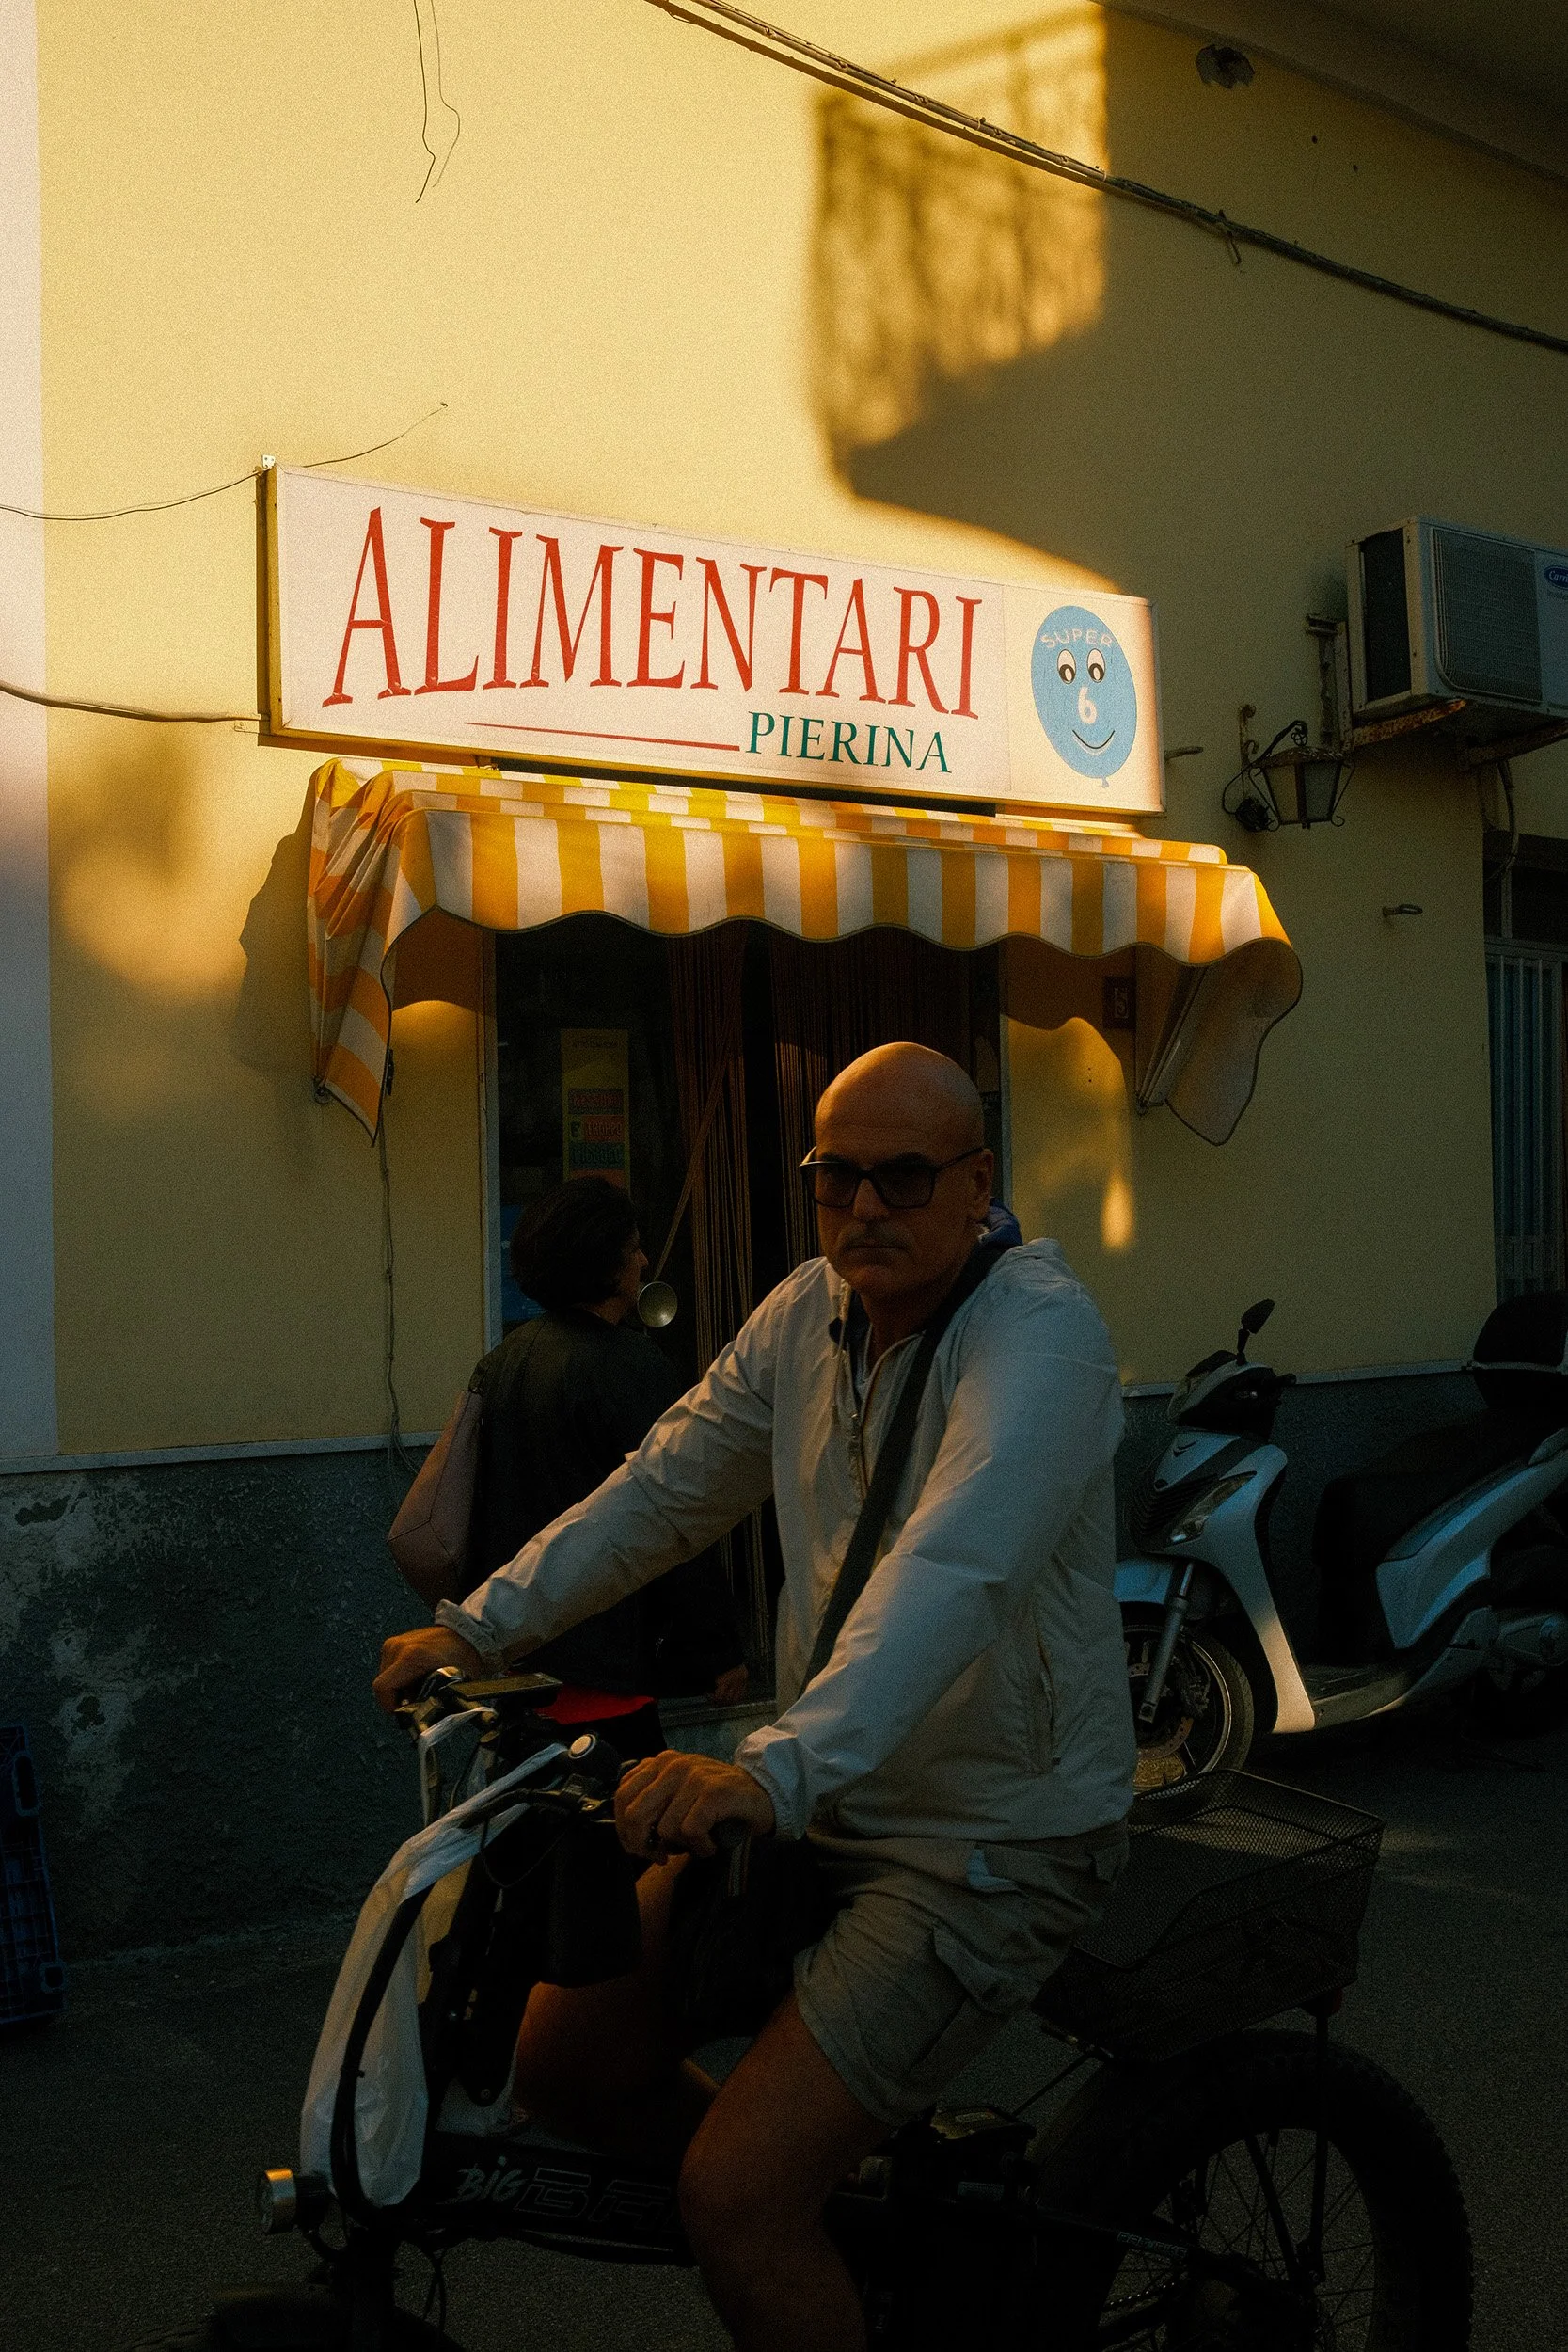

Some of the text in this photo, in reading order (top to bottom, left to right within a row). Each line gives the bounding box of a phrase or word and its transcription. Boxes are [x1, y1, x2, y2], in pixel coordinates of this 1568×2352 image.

[322, 505, 983, 719] ALIMENTARI
[1039, 628, 1115, 648] SUPER
[1078, 686, 1099, 724] 6
[748, 710, 952, 773] PIERINA
